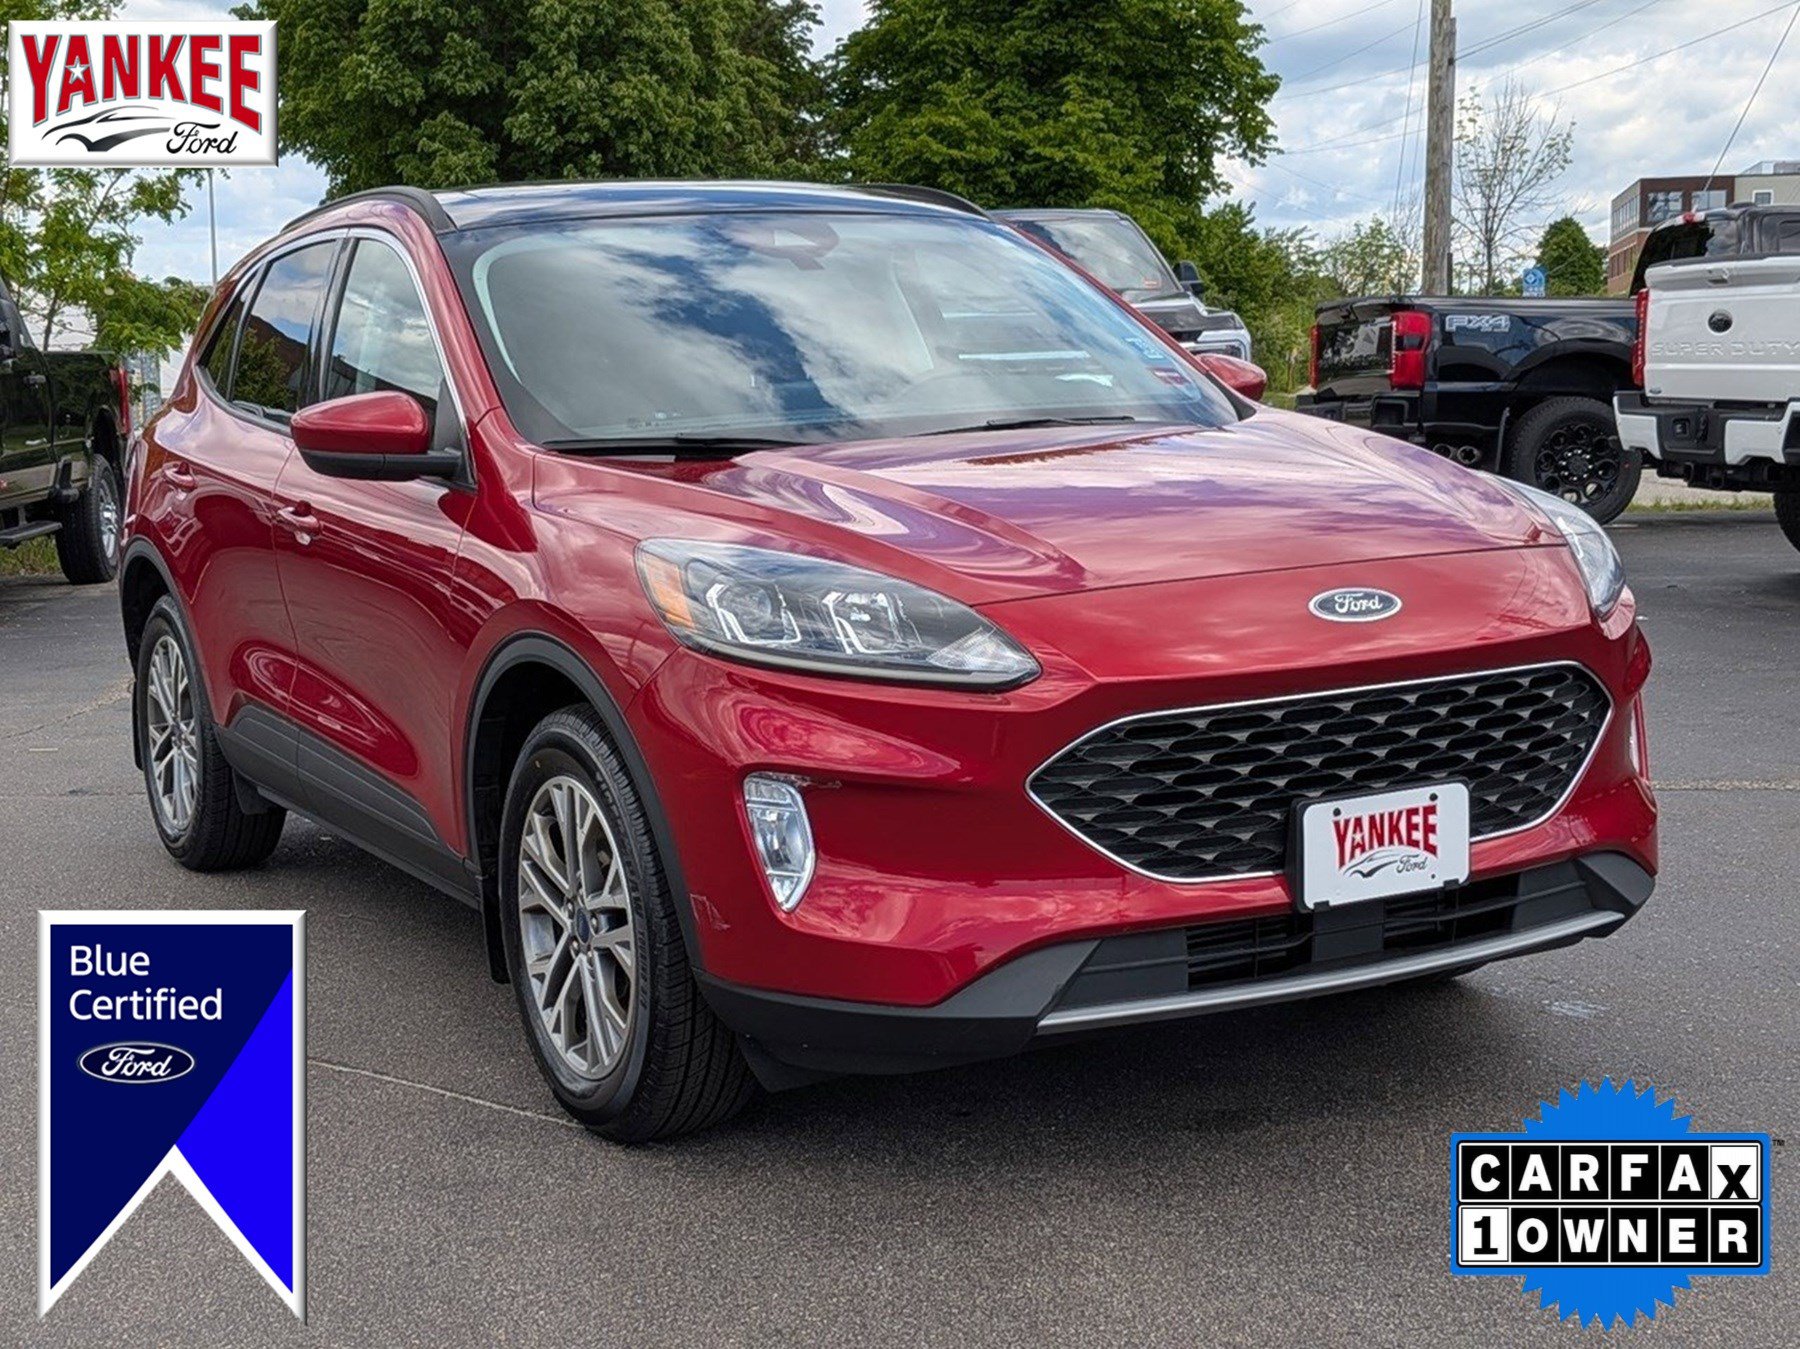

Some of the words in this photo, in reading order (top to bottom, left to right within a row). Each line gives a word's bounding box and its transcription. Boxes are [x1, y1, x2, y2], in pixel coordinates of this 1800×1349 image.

[1651, 341, 1724, 356] SUPER
[1730, 340, 1800, 356] DUTY
[1334, 592, 1383, 613] Ford
[1332, 803, 1438, 871] YANKEE
[1396, 853, 1429, 874] Ford
